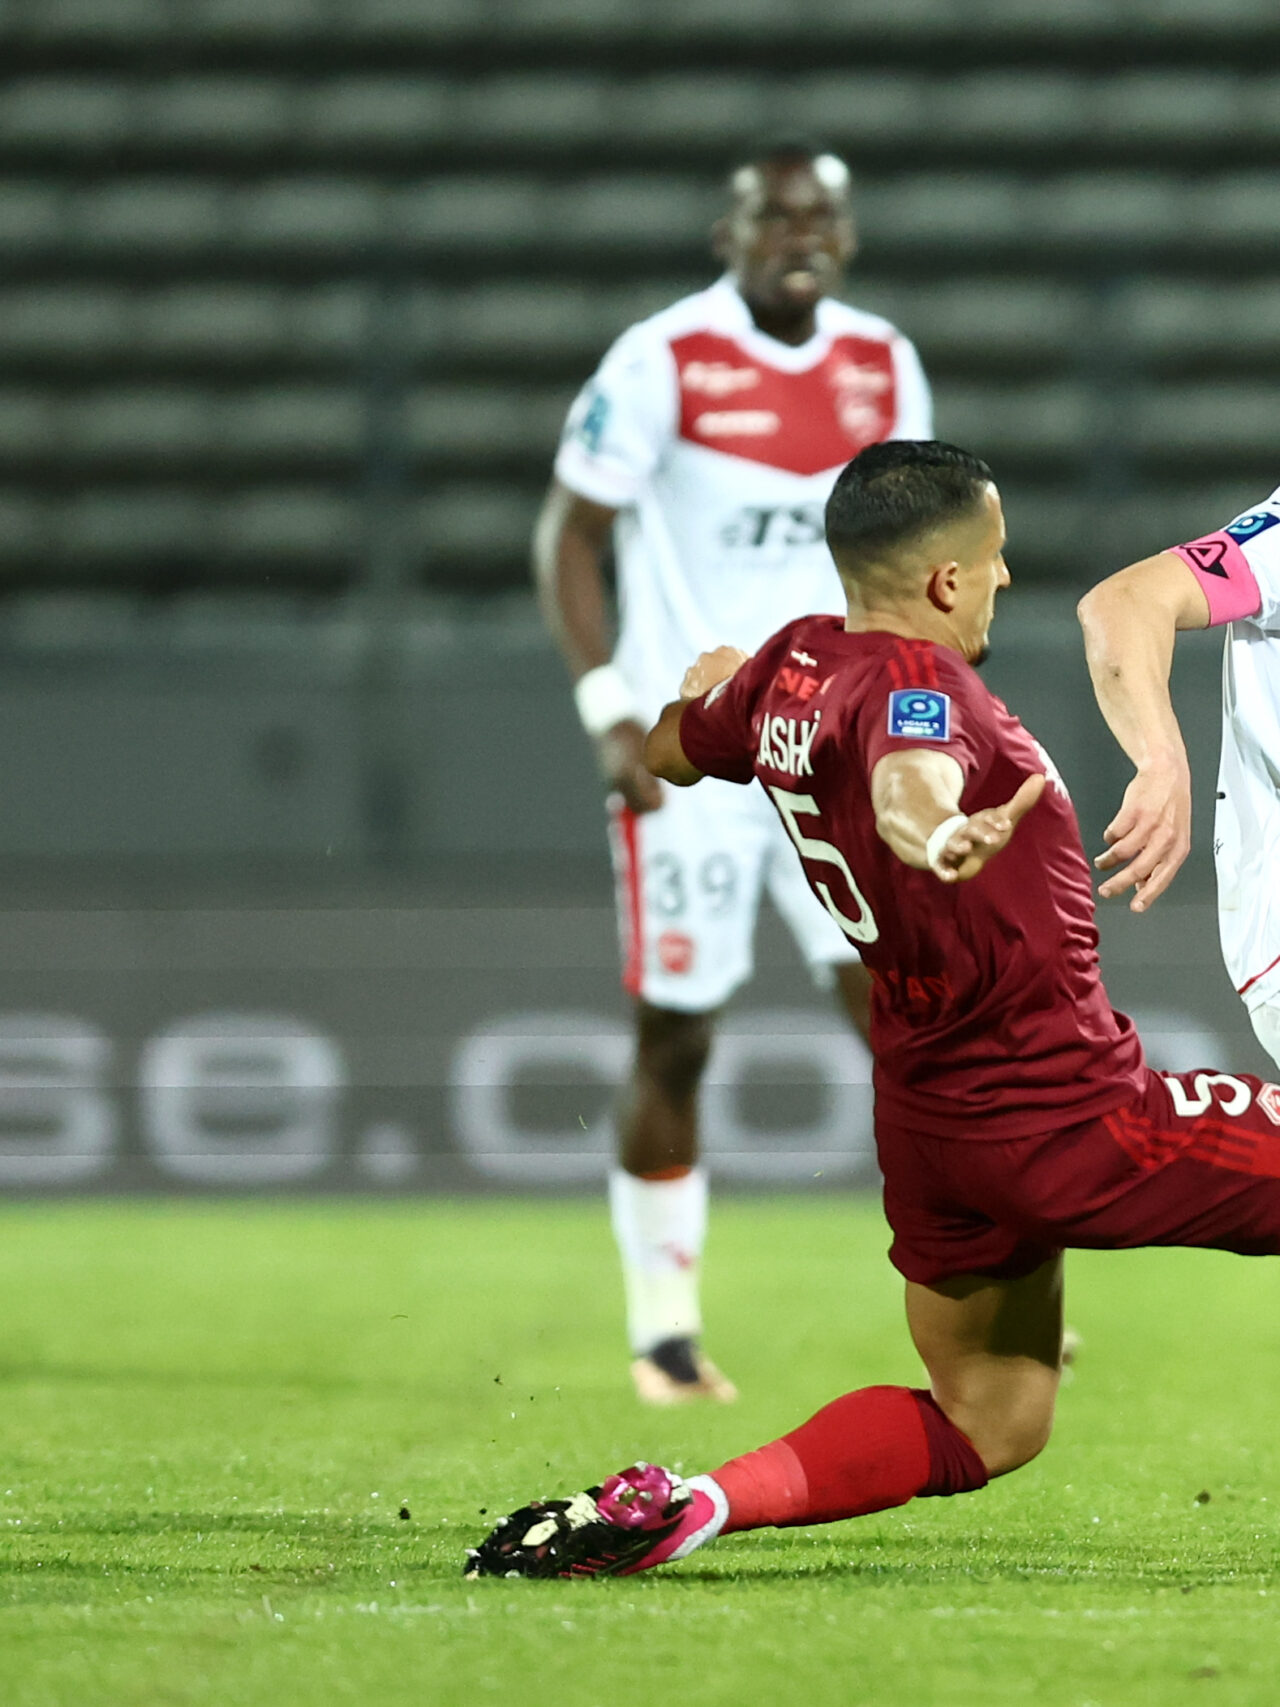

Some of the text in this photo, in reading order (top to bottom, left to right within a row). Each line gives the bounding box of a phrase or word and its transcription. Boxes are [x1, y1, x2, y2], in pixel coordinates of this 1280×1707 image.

[757, 710, 822, 777] ASHI
[897, 719, 931, 728] LIGUE
[646, 850, 739, 917] 39
[768, 785, 880, 945] 5
[1164, 1073, 1252, 1117] 5
